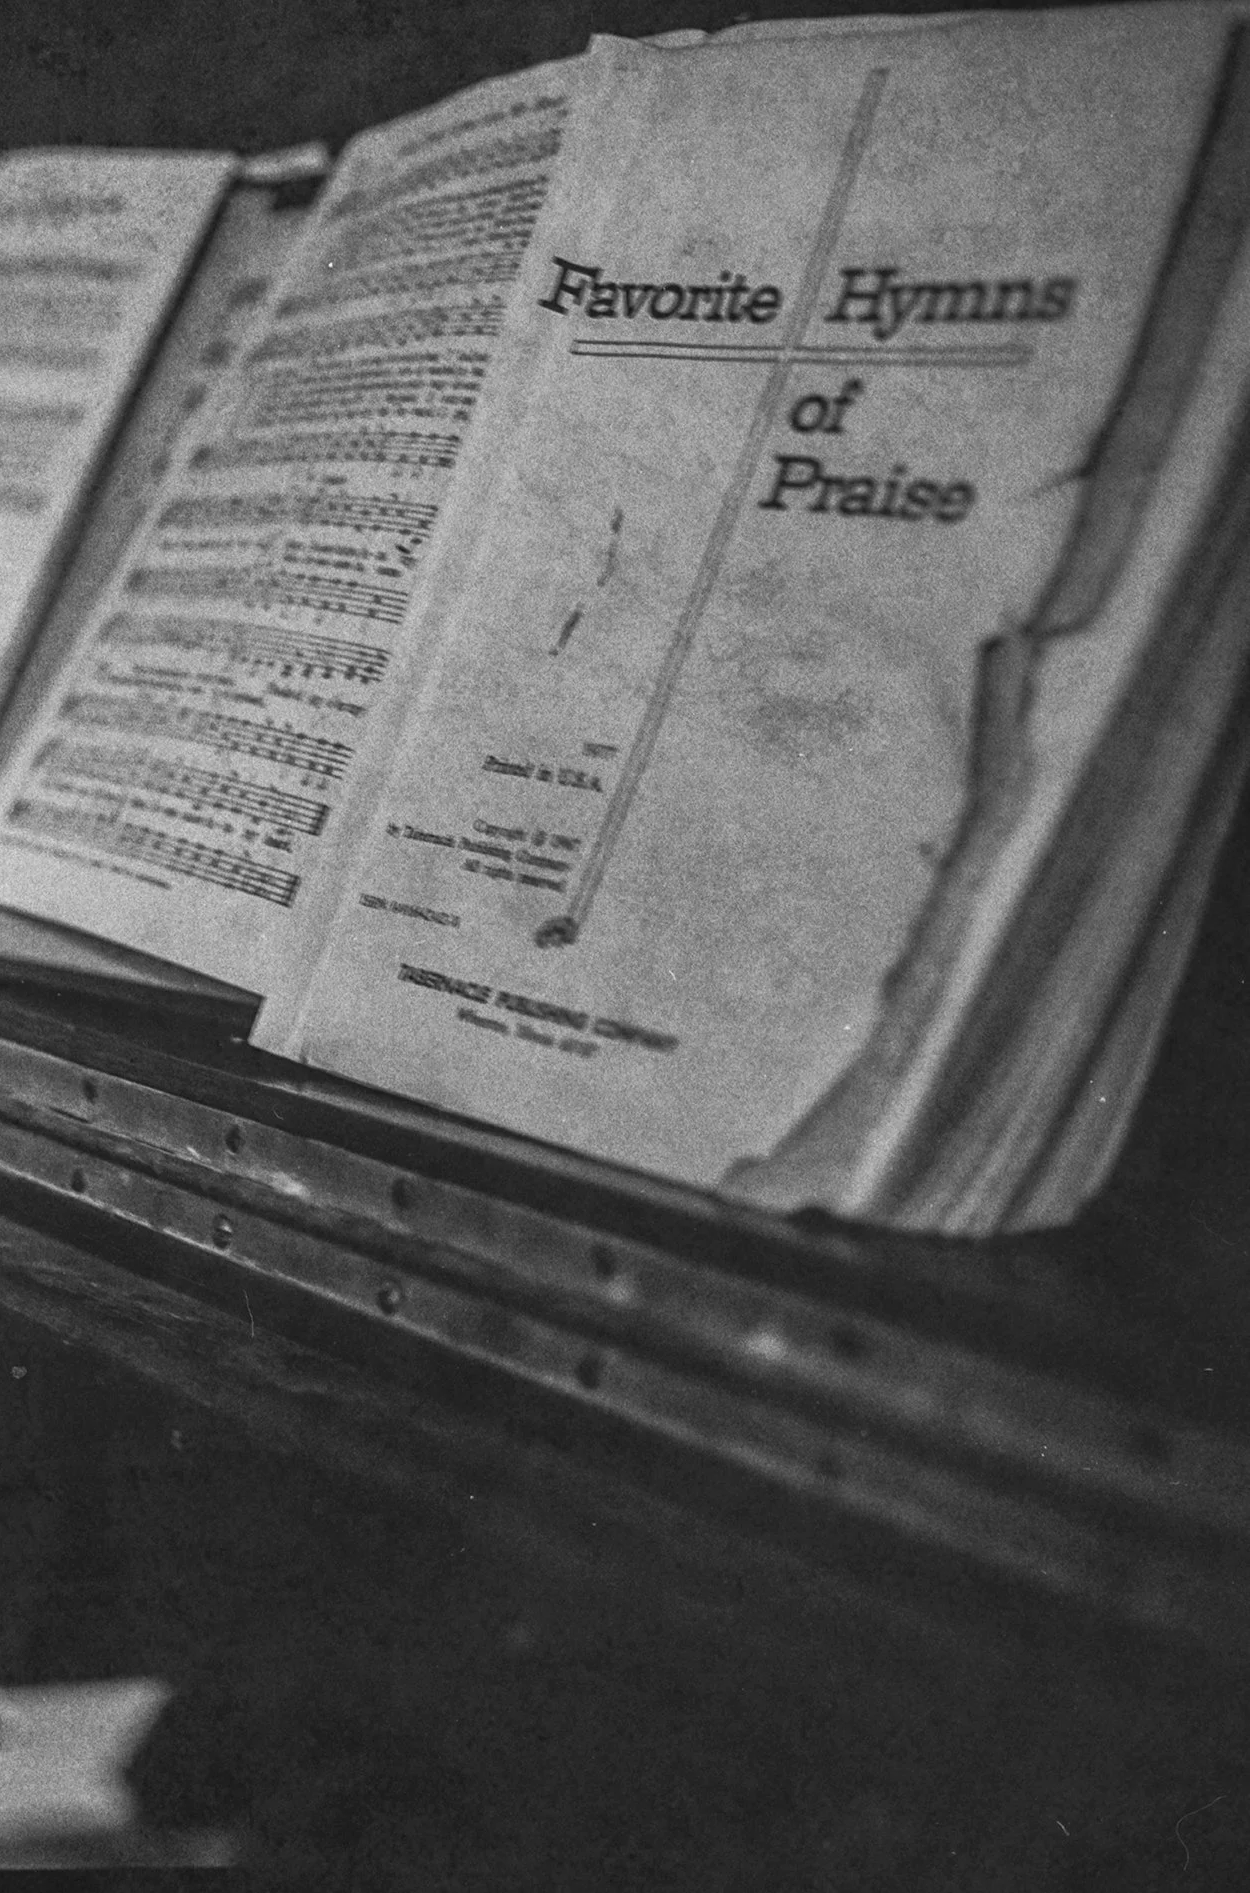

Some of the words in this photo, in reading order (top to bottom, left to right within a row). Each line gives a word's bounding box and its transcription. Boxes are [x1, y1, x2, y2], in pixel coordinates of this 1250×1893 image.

[538, 255, 783, 322] Favorite
[824, 267, 1080, 341] Hymns
[788, 378, 864, 434] of
[757, 453, 977, 524] Praise
